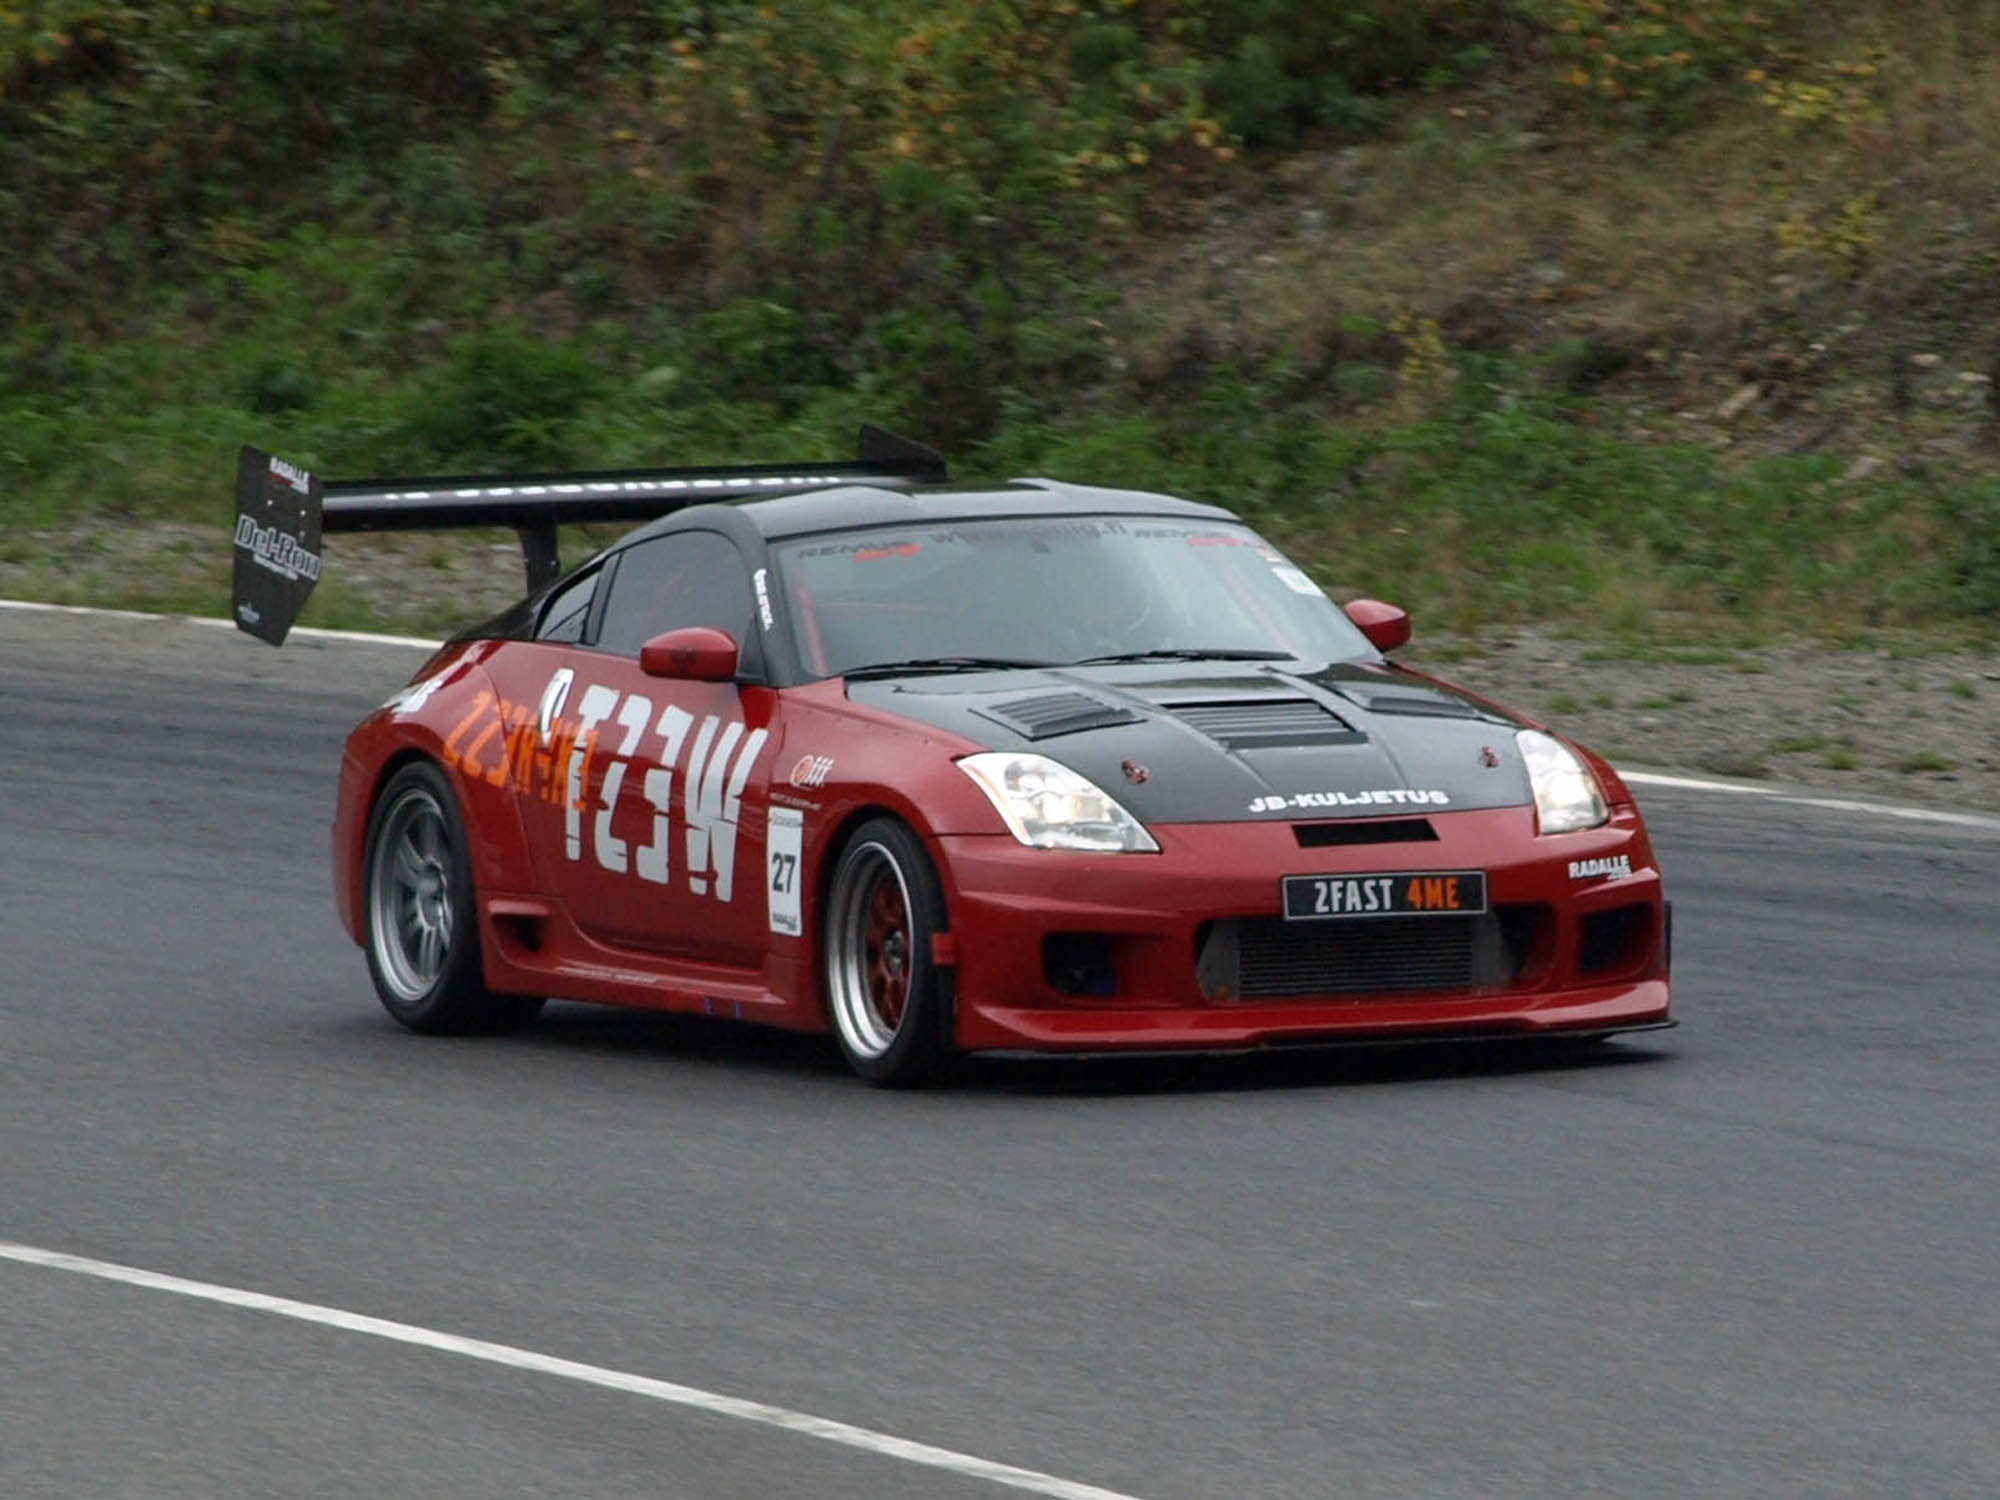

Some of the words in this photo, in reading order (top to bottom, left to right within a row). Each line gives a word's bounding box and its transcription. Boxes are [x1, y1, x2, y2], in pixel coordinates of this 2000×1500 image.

[1248, 790, 1450, 813] JB-KULJETUS
[771, 851, 797, 895] 27
[1568, 854, 1630, 879] RADALLE
[1314, 878, 1393, 914] 2FAST
[1405, 877, 1460, 911] 4ME
